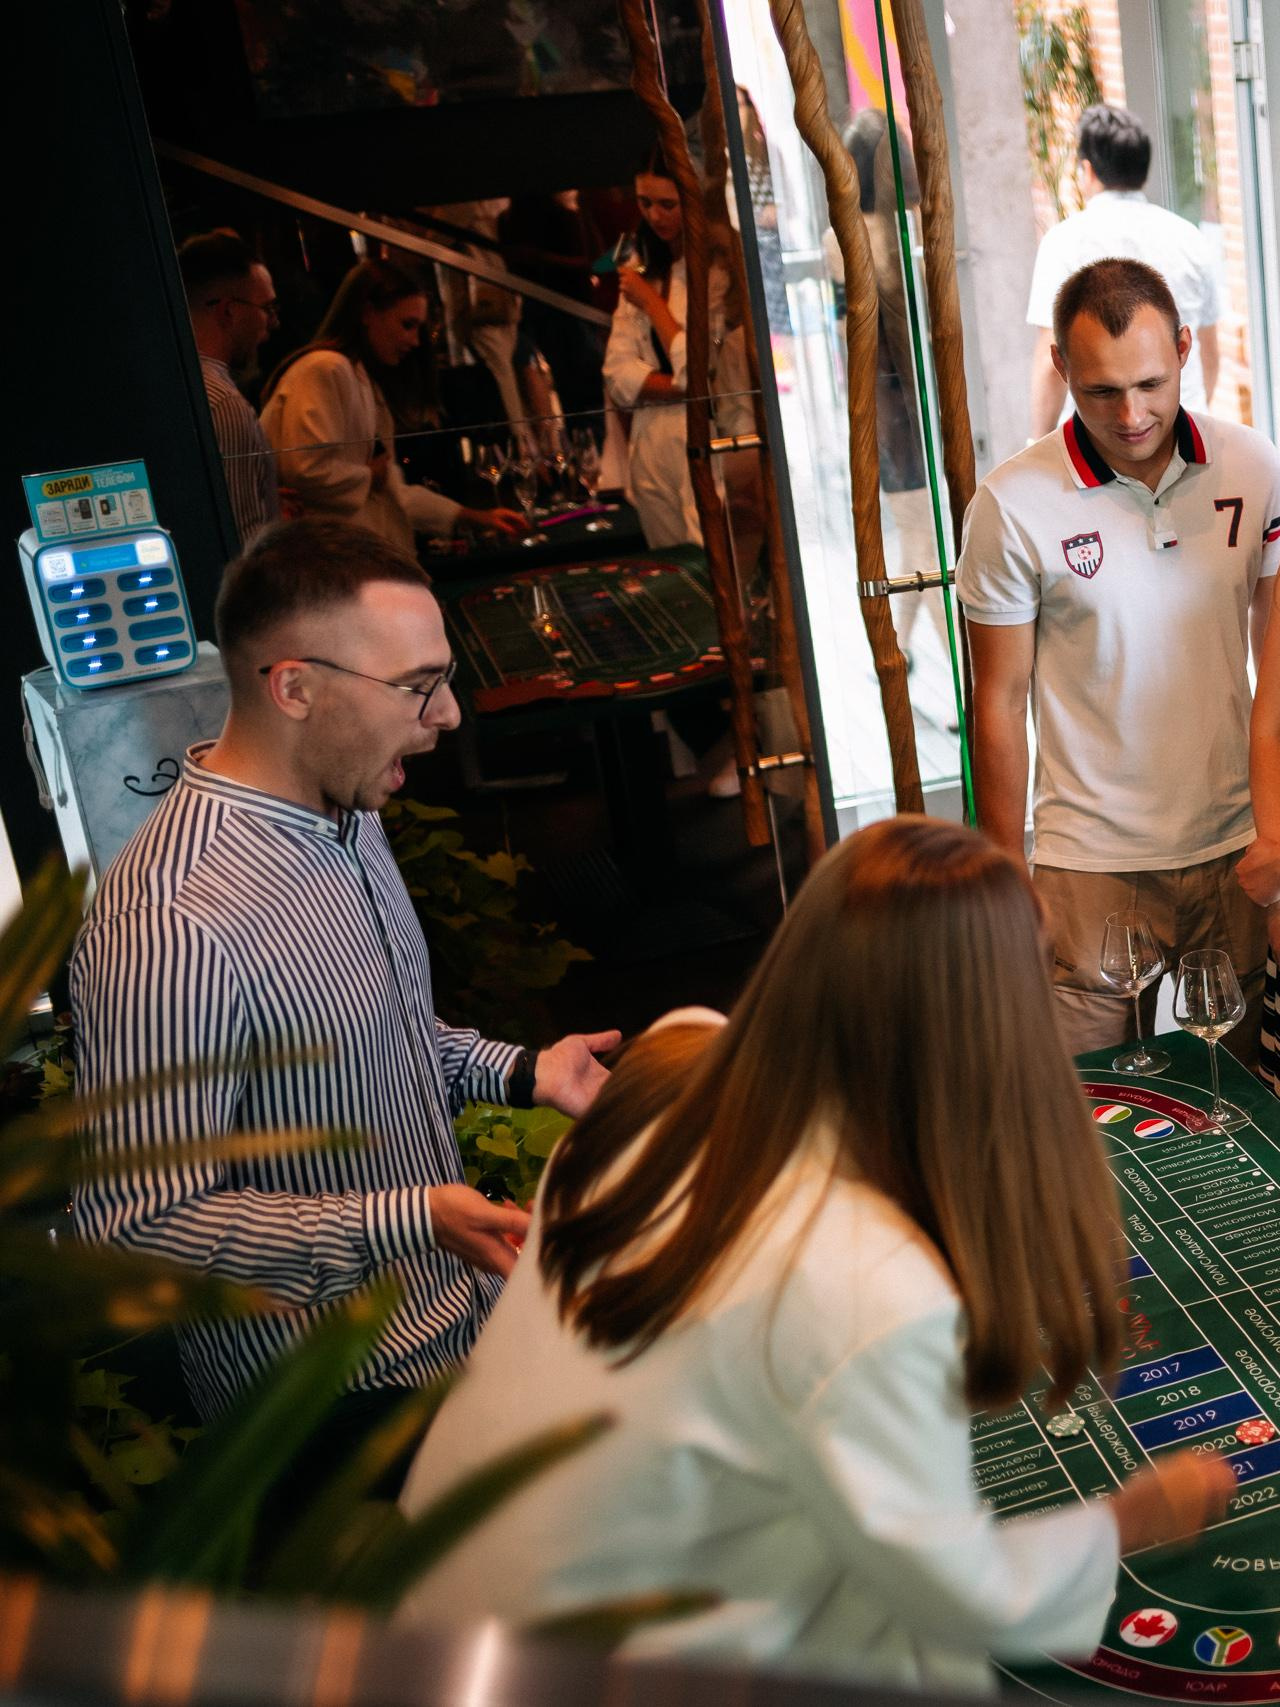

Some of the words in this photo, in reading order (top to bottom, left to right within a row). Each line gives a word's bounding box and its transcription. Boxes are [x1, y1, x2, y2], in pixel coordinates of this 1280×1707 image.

[46, 476, 91, 495] ЗАРЯДИ
[1214, 497, 1243, 547] 7
[1161, 1138, 1202, 1153] Другой
[1177, 1163, 1239, 1183] Ркацители
[1202, 1177, 1240, 1191] Виура
[1123, 1167, 1158, 1202] сладкое
[1197, 1191, 1272, 1214] Верментино
[1128, 1214, 1155, 1243] бленд
[1212, 1207, 1277, 1229] Мальвазия
[1175, 1228, 1231, 1286] полусладкое
[1139, 1362, 1180, 1383] 2017
[1156, 1385, 1202, 1406] 2018
[1173, 1409, 1217, 1431] 2019
[1087, 1404, 1138, 1471] выдержано
[1191, 1434, 1238, 1456] 2020
[1230, 1486, 1278, 1511] 2022
[1185, 1680, 1229, 1693] ЮАР
